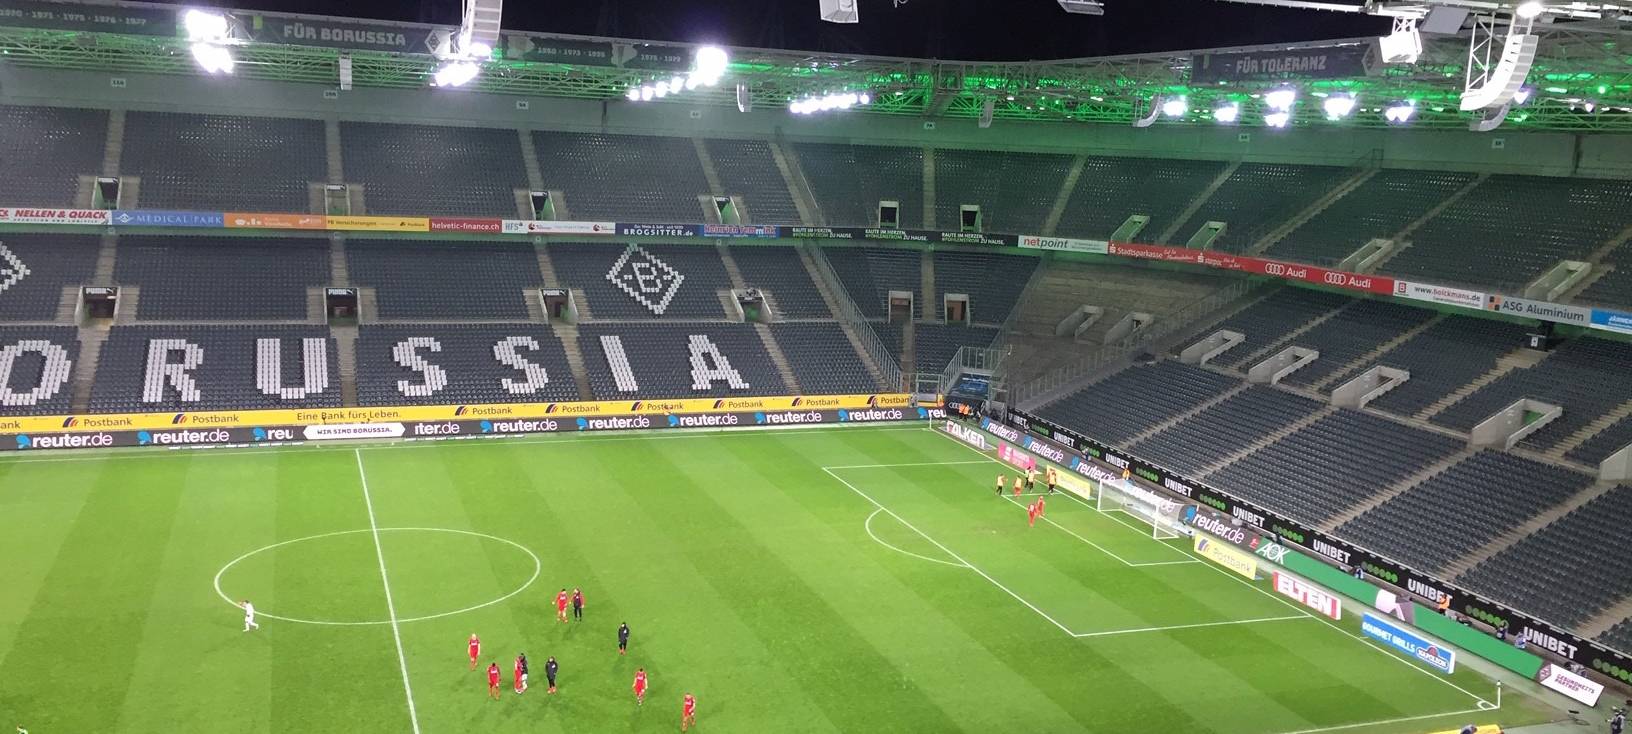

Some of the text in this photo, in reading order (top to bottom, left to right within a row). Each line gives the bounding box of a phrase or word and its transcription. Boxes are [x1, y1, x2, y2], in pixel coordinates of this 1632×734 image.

[283, 22, 407, 46] FÜR BORUSSIA
[1236, 55, 1327, 74] FÜR TOLERANZ
[15, 209, 108, 220] NELLEN & QUACK
[136, 214, 222, 225] MEDICAL PARK
[431, 221, 500, 231] helvetic-finance.ch
[623, 228, 694, 237] BROGSITTER.de
[1023, 237, 1069, 249] netpoint
[1117, 247, 1164, 260] Stadtsparkasse
[1286, 267, 1307, 279] Audi
[1348, 276, 1371, 288] Audi
[1502, 301, 1585, 322] ASG Aluminium
[728, 400, 764, 409] Postbank
[806, 397, 840, 407] Postbank
[880, 396, 910, 405] Postban
[297, 409, 402, 421] Eine Bank fürs Leben.
[472, 406, 513, 416] Postbank
[562, 404, 601, 413] Postbank
[848, 408, 903, 421] reuter.de
[83, 418, 133, 428] Postbank
[191, 414, 239, 424] Postbank
[588, 415, 650, 429] reuter.de
[679, 412, 738, 426] reuter.de
[765, 410, 822, 424] reuter.de
[492, 418, 558, 433] reuter.de
[986, 420, 1018, 442] reuter.de
[32, 432, 113, 448] reuter.de
[153, 428, 230, 445] reuter.de
[946, 420, 985, 450] FALKEN
[1053, 430, 1075, 448] UNIBET
[1028, 440, 1064, 462] reuter.de
[1105, 452, 1130, 470] UNIBET
[1075, 460, 1117, 483] reuter.de
[1164, 477, 1193, 497] UNIBET
[1232, 505, 1265, 528] UNIBET
[1192, 512, 1245, 545] reuter.de
[1256, 541, 1295, 565] AOK
[1312, 539, 1351, 564] UNIBET
[1212, 546, 1252, 574] Postbank
[1277, 572, 1333, 616] ELTEN
[1407, 577, 1454, 605] UNIBET
[1522, 625, 1579, 660] UNIBET
